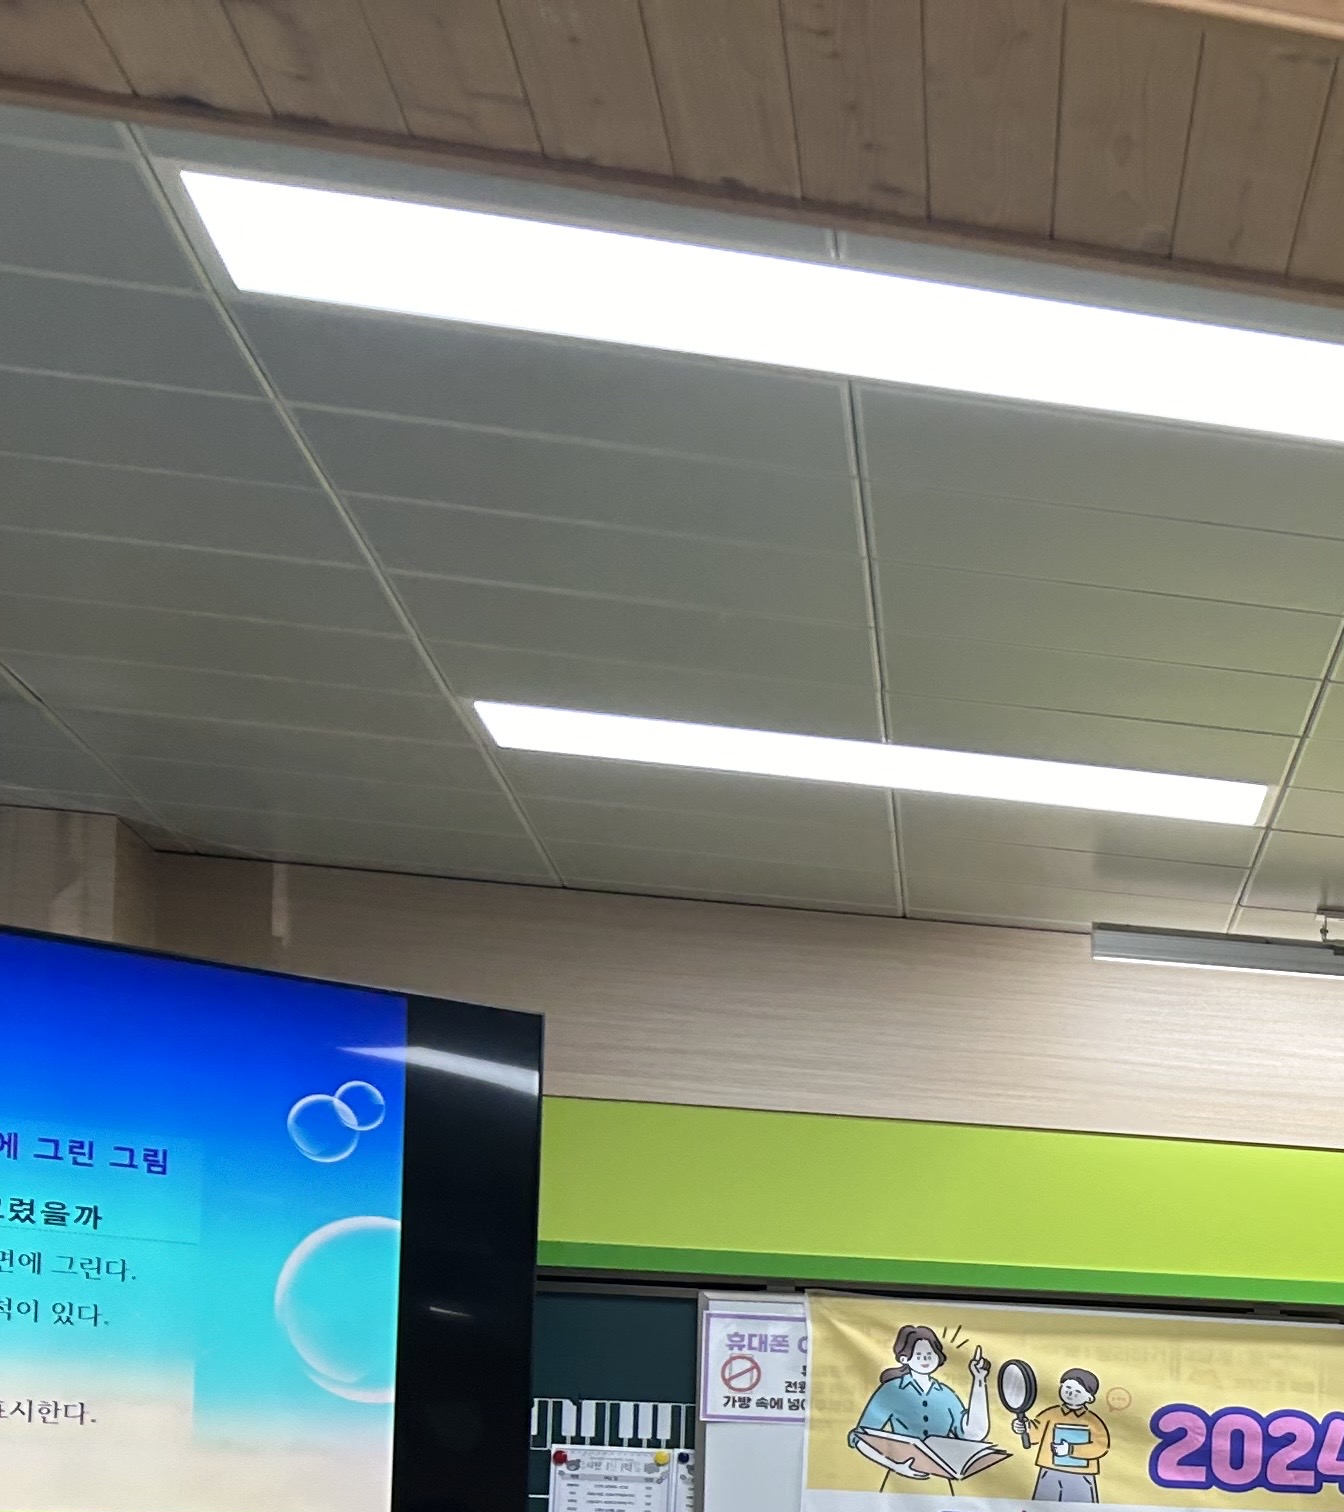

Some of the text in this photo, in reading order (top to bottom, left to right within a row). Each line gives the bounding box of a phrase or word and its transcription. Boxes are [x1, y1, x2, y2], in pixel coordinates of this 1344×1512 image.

[33, 1137, 95, 1167] 그린
[108, 1145, 169, 1175] 그림
[0, 1197, 102, 1230] 렸을까
[51, 1255, 137, 1283] 그린다.
[52, 1301, 110, 1327] 있다.
[725, 1331, 790, 1353] 휴대폰
[723, 1396, 752, 1409] 가방
[755, 1397, 783, 1410] 속에
